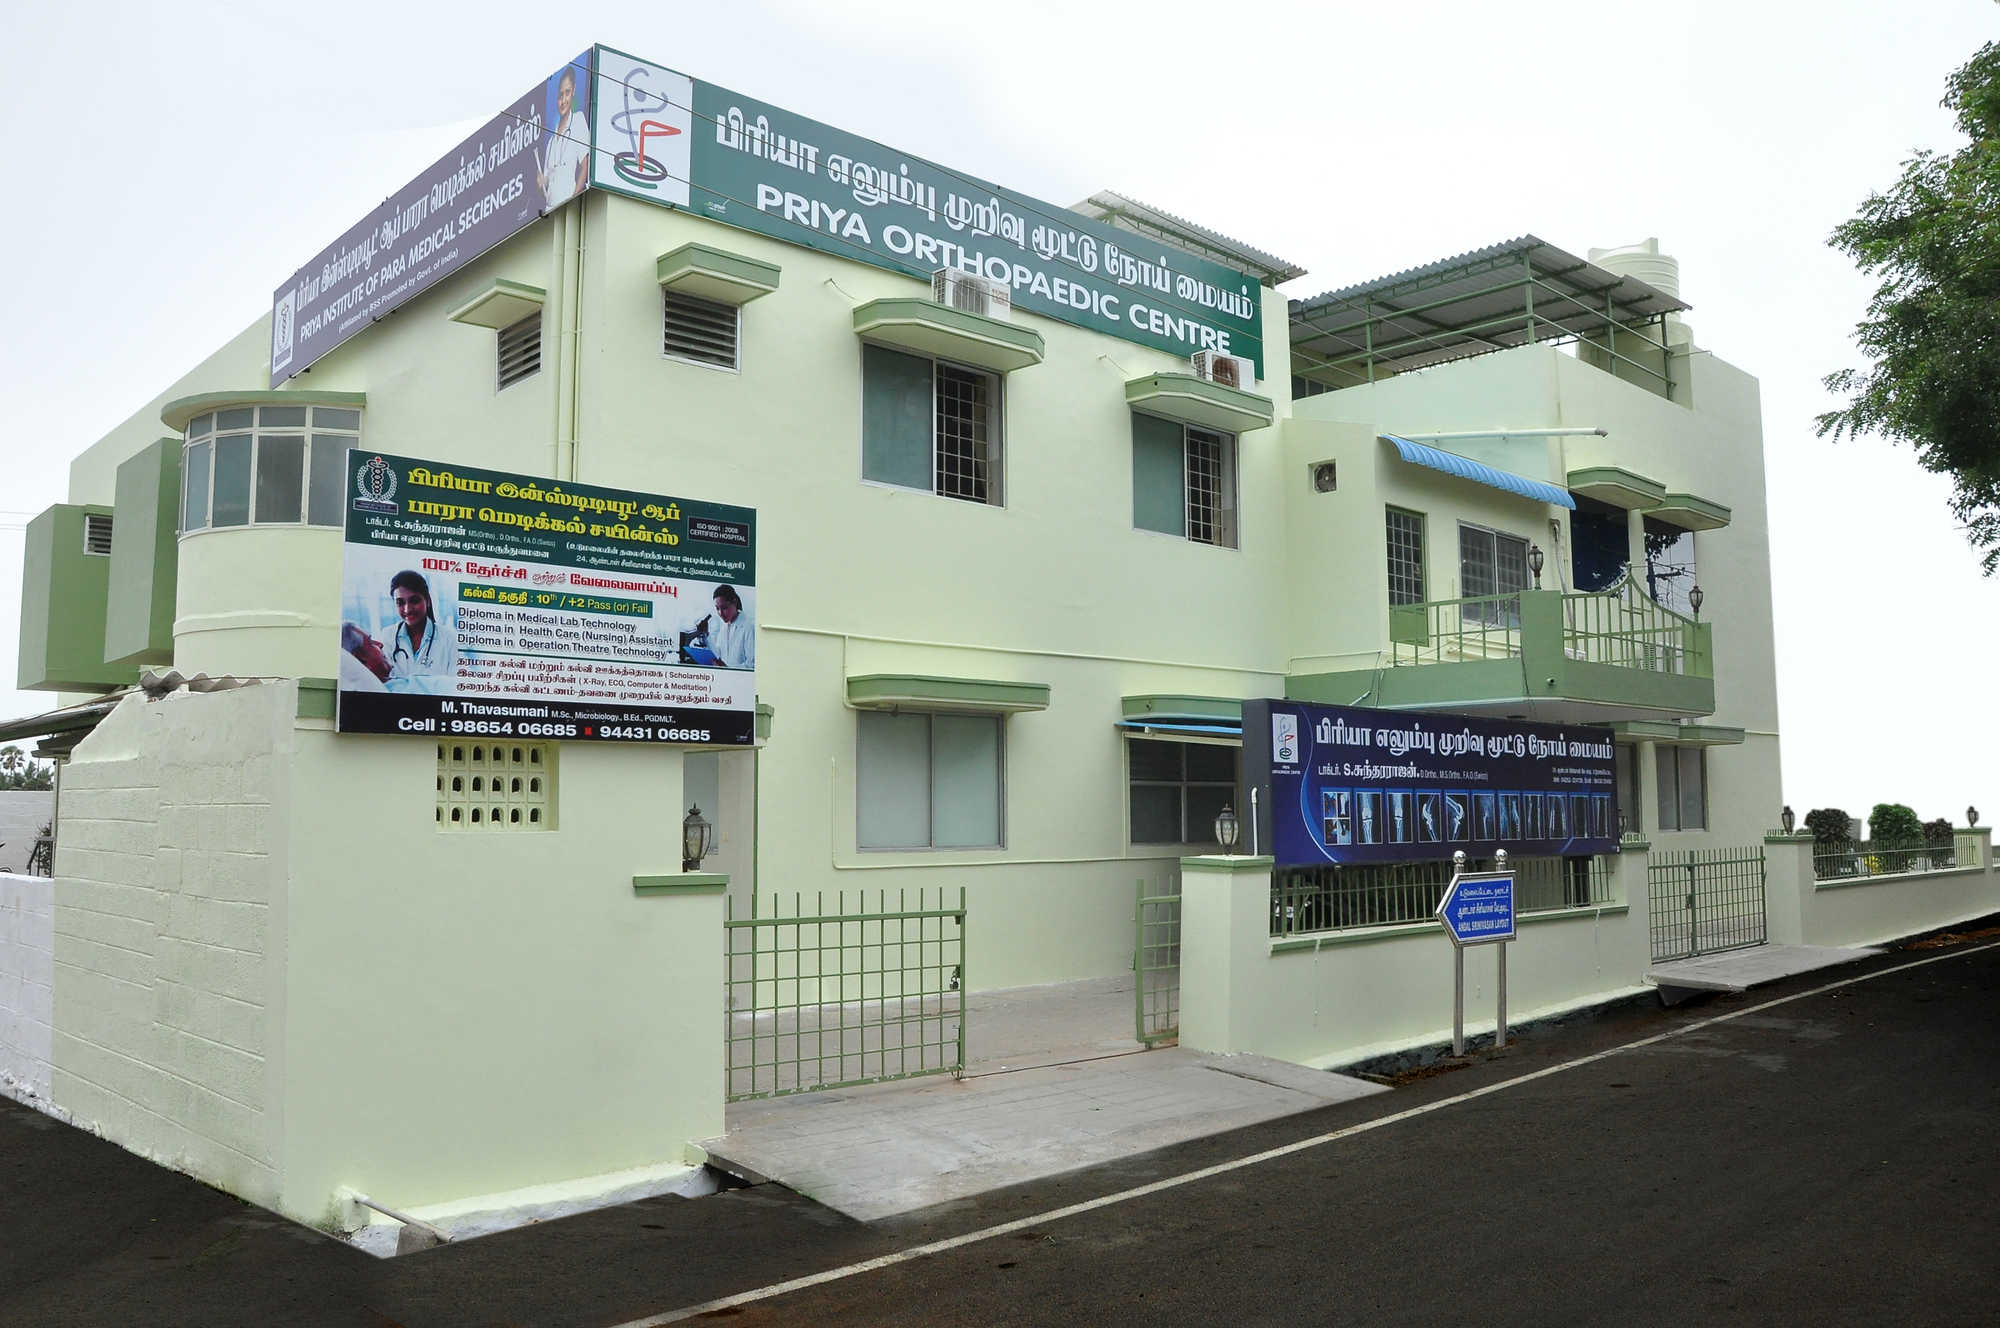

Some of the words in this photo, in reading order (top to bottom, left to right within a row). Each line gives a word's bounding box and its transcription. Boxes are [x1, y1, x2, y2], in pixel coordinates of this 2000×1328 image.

[430, 143, 486, 214] மெடிக்கல்
[488, 104, 542, 172] சயின்ஸ்
[716, 106, 819, 175] பிரியா
[827, 154, 936, 222] எலும்பு
[944, 193, 1026, 248] முறிவு
[1032, 224, 1098, 273] மூட்டு
[1104, 242, 1171, 293] நோய்
[1176, 274, 1254, 321] மையம்
[300, 312, 322, 344] PRIYA
[323, 282, 364, 328] INSTITUTE
[365, 272, 379, 296] OF
[380, 254, 406, 288] PARA
[408, 220, 456, 269] MEDICAL
[458, 173, 523, 235] SECIENCES
[757, 183, 872, 244] PRIYA
[882, 224, 1119, 321] ORTHOPAEDIC
[1129, 304, 1232, 354] CENTRE
[408, 468, 492, 495] பிரியா
[642, 502, 680, 521] ஆப்
[408, 499, 474, 521] பாரா
[479, 507, 586, 535] மெடிக்கல்
[590, 523, 679, 546] சயின்ஸ்
[690, 529, 718, 538] CERTIFIED
[720, 533, 746, 542] HOSPITAL
[371, 530, 398, 541] பிரியா
[401, 534, 432, 546] எலும்பு
[422, 558, 462, 573] 100%
[466, 561, 527, 580] தேர்ச்சி
[570, 573, 678, 597] வேலைவாய்ப்பு
[463, 586, 496, 600] கல்வி
[498, 591, 528, 604] தகுதி
[569, 598, 585, 608] +2
[587, 600, 611, 611] Pass
[613, 602, 630, 614] (or)
[632, 603, 649, 614] Fail
[458, 607, 501, 623] Diploma
[504, 611, 514, 621] in
[517, 612, 558, 625] Medical
[560, 616, 579, 626] Lab
[581, 618, 637, 633] Technology
[458, 621, 501, 637] Diploma
[504, 624, 514, 634] in
[519, 626, 553, 638] Health
[555, 629, 579, 640] Care
[582, 631, 627, 645] (Nursing)
[628, 634, 673, 646] Assistant
[458, 634, 501, 650] Diploma
[504, 637, 514, 647] in
[519, 638, 570, 653] Operation
[573, 642, 610, 654] Theatre
[612, 646, 667, 660] Technology
[457, 669, 491, 679] இலவச
[627, 680, 662, 690] Computer
[671, 683, 708, 692] Meditation
[499, 659, 526, 669] கல்வி
[529, 661, 565, 672] மற்றும்
[567, 663, 592, 673] கல்வி
[669, 671, 710, 681] Scholarship
[503, 684, 530, 694] கல்வி
[442, 701, 458, 714] M.
[460, 702, 548, 718] Thavasumani
[398, 718, 435, 731] Cell
[451, 720, 513, 735] 98654
[518, 722, 577, 737] 06685
[600, 726, 652, 739] 94431
[658, 728, 711, 741] 06685
[1316, 716, 1371, 746] பிரியா
[1376, 722, 1435, 756] எலும்பு
[1439, 728, 1484, 757] முறிவு
[1488, 734, 1525, 759] மூட்டு
[1528, 733, 1567, 760] நோய்
[1569, 737, 1613, 760] மையம்
[1495, 918, 1510, 929] LAYOUT
